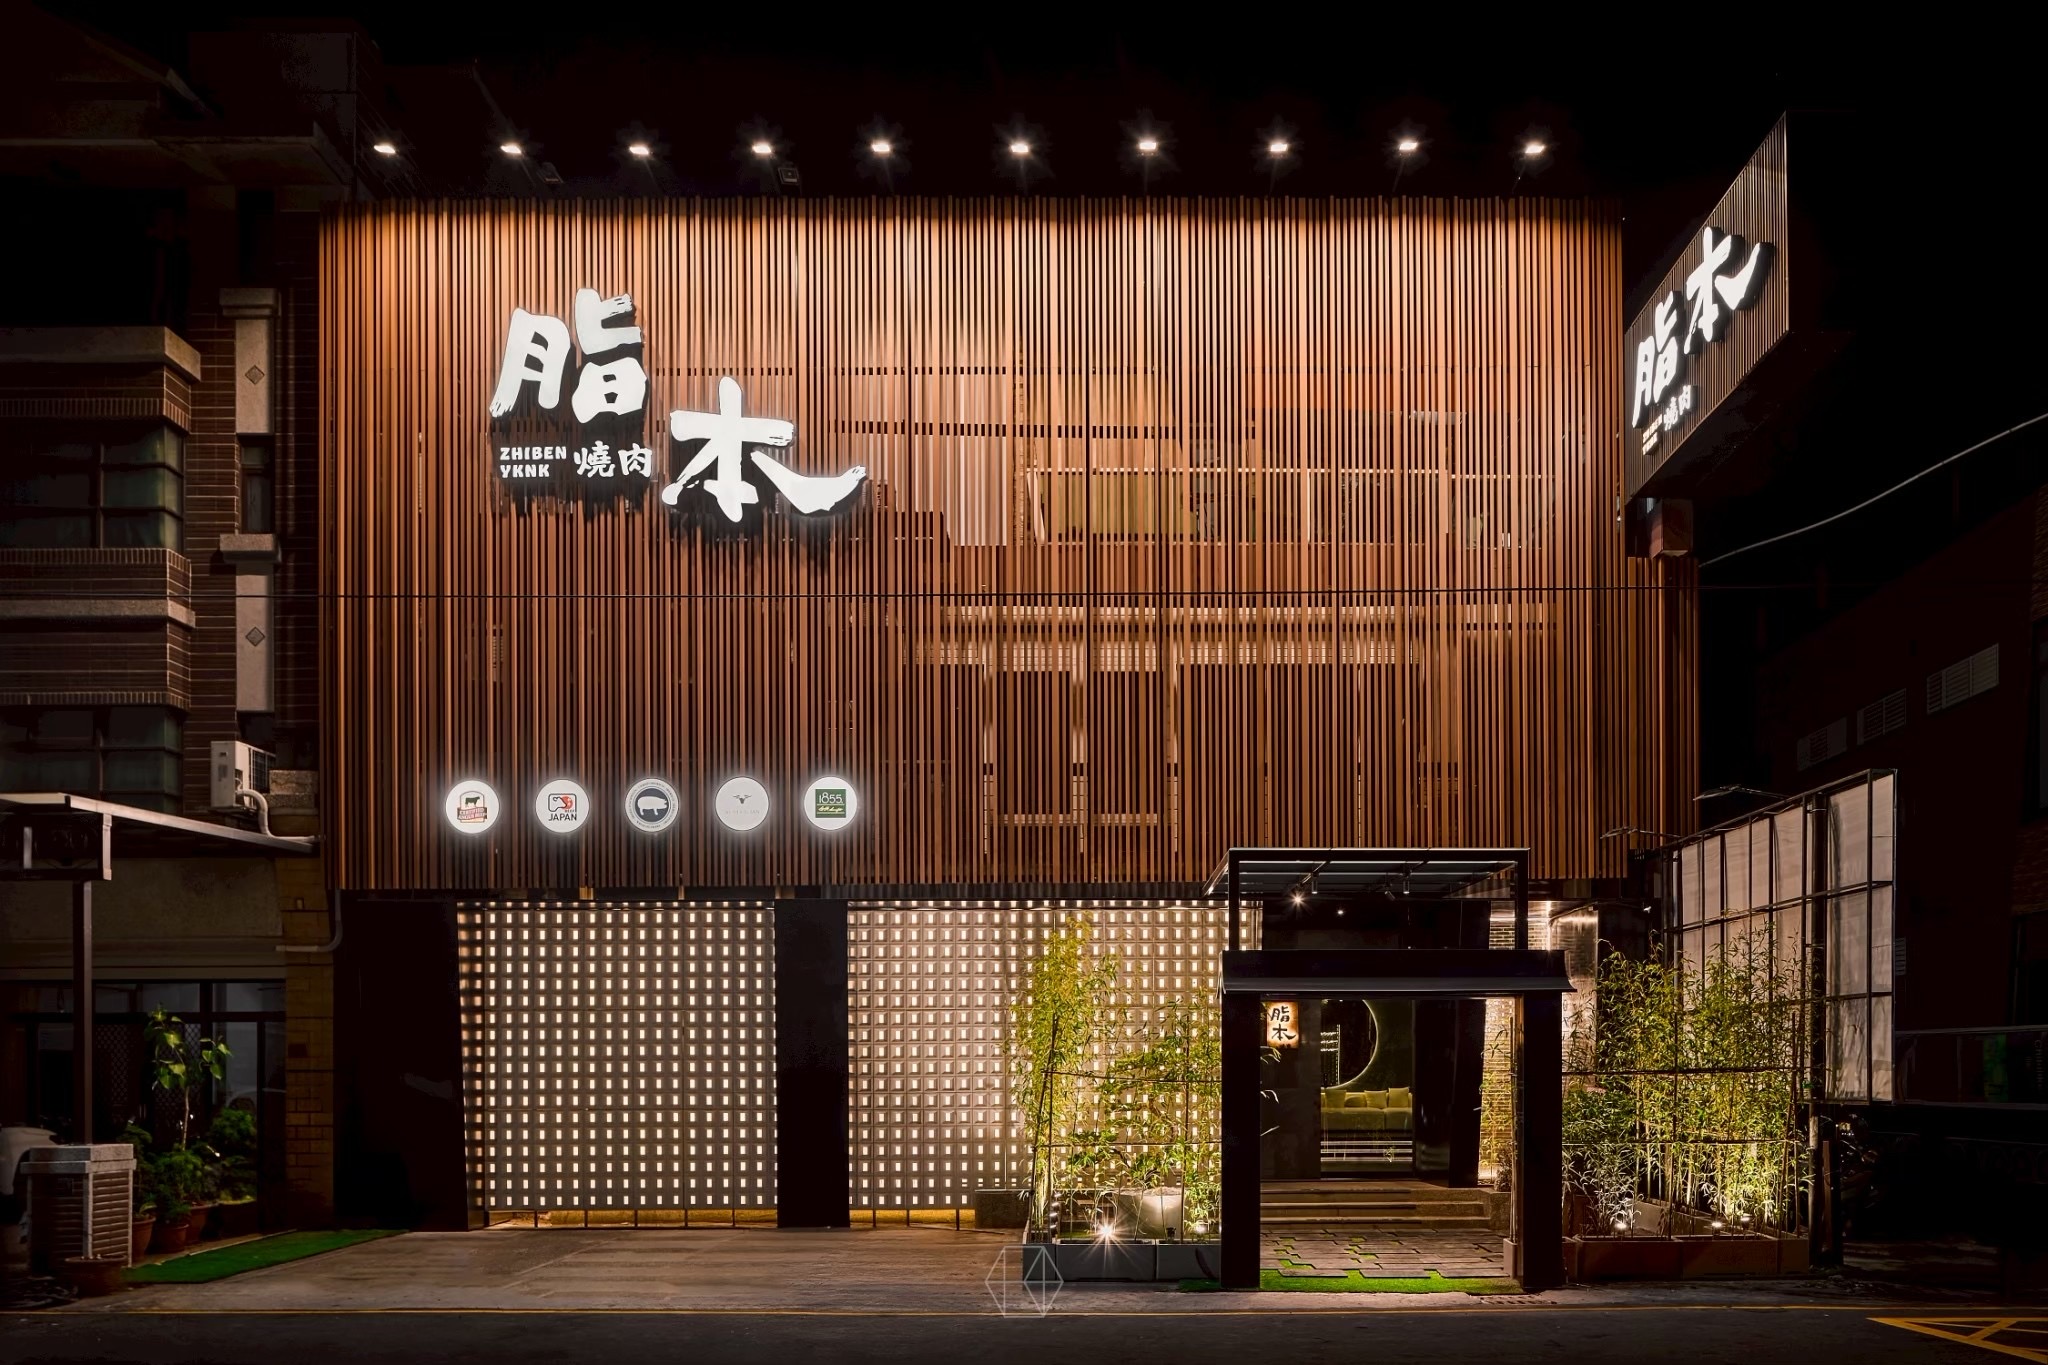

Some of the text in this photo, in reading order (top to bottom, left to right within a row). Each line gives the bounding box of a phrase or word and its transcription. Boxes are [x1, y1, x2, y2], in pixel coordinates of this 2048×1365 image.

[1632, 226, 1760, 428] 脂本
[489, 287, 868, 523] 脂本
[499, 446, 567, 461] ZHIBEN
[499, 463, 551, 479] YKNK
[573, 440, 653, 479] 燒肉
[548, 813, 577, 821] JAPAN
[1270, 1005, 1297, 1041] 脂本
